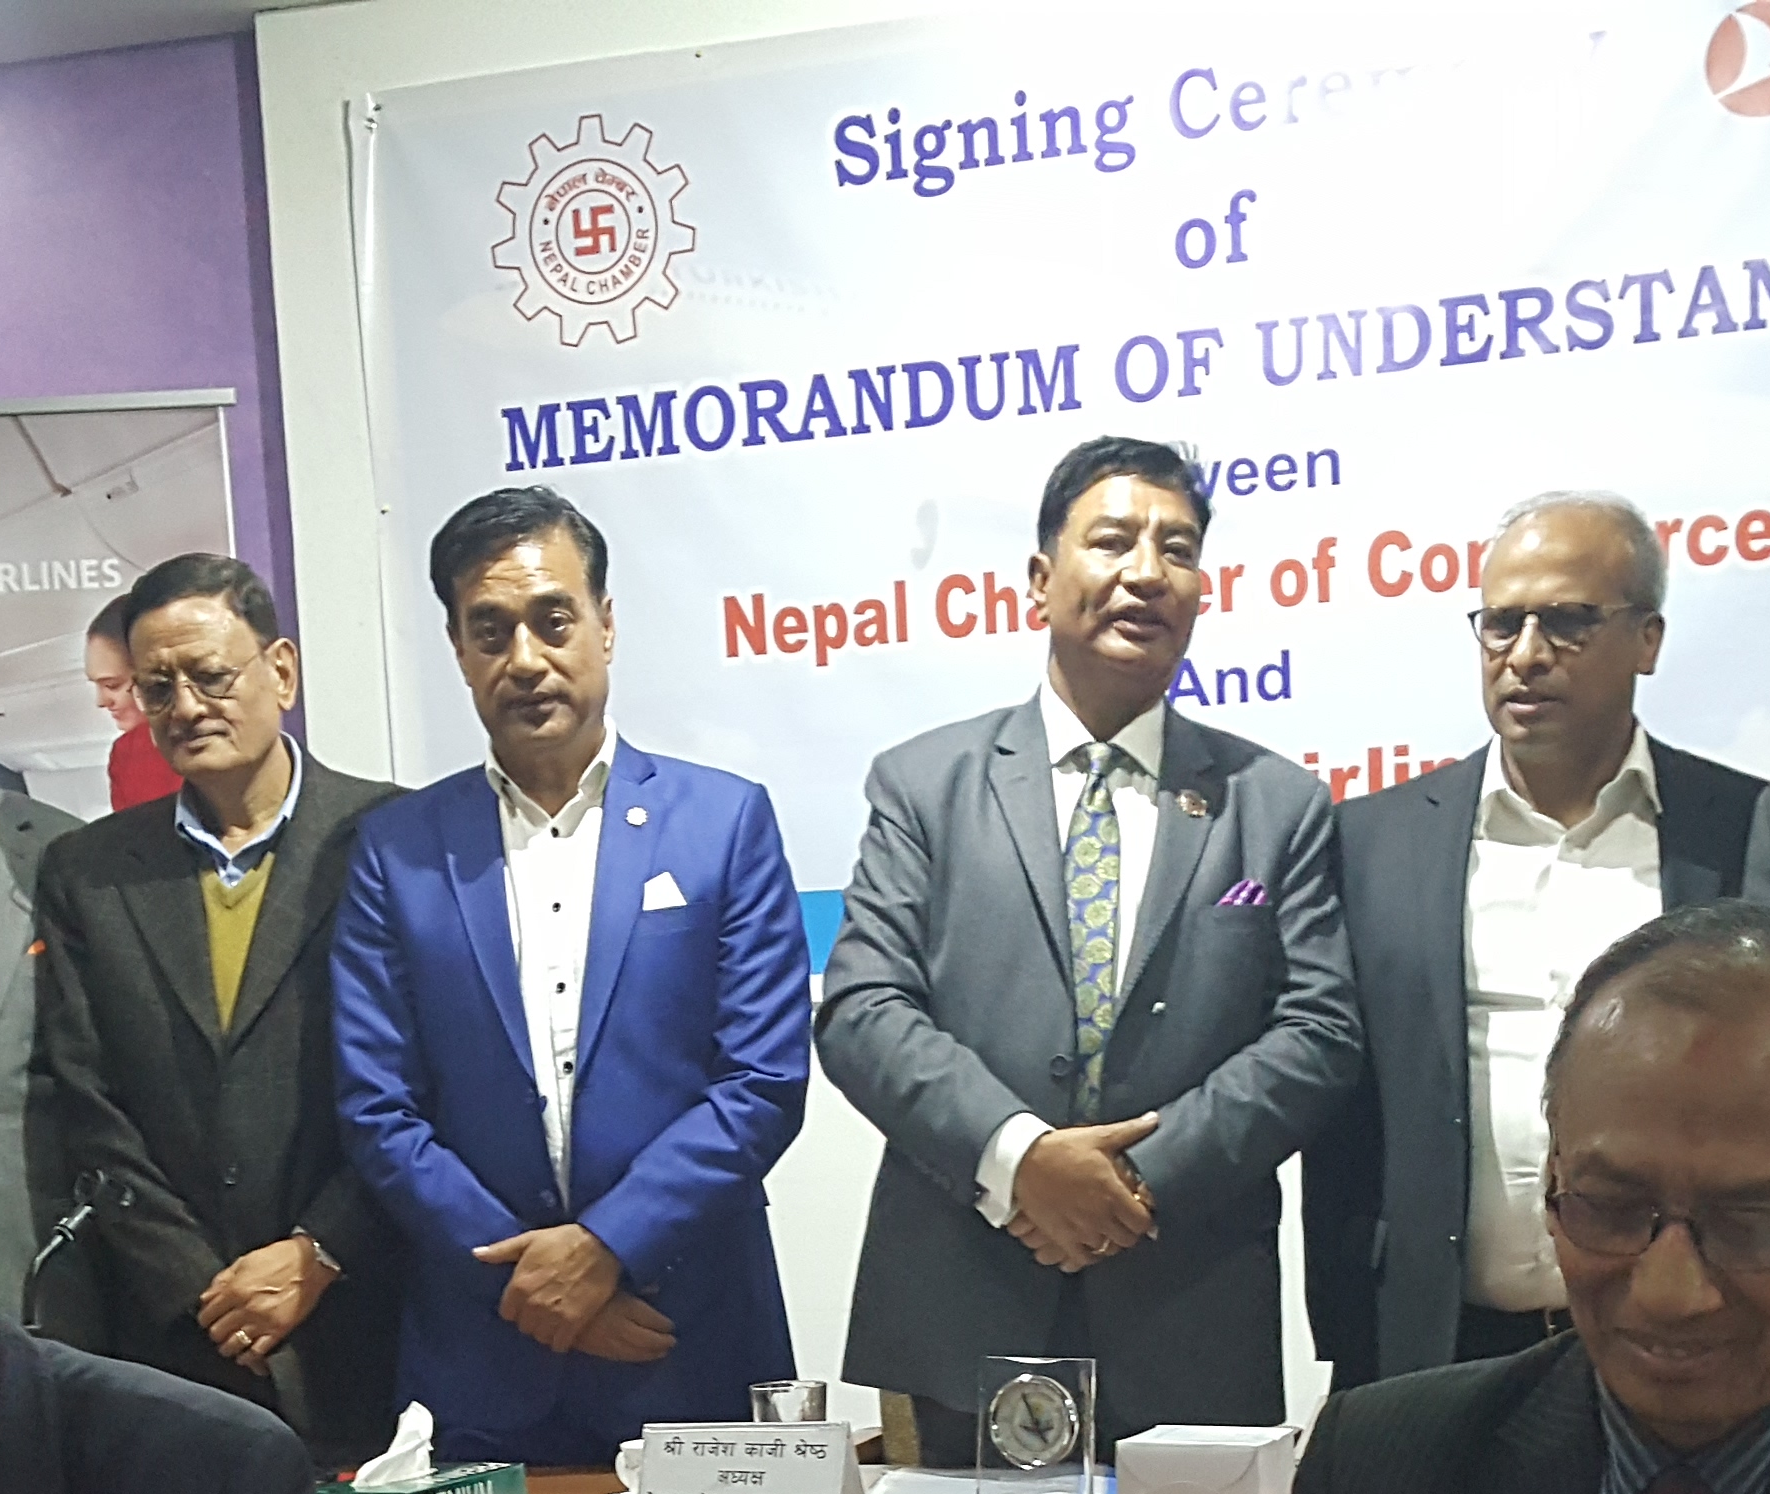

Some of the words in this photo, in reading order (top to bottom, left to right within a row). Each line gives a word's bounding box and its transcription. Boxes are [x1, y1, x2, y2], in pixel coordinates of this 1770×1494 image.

[834, 91, 1136, 198] Signing
[539, 240, 577, 293] NEPAL
[586, 228, 650, 295] CHAMBER
[1175, 189, 1257, 269] of
[501, 343, 1083, 474] MEMORANDUM
[1114, 327, 1225, 406] OF
[723, 579, 909, 668] Nepal
[1270, 536, 1338, 608] of
[1167, 649, 1293, 706] And
[692, 1437, 737, 1458] राजेश
[743, 1438, 787, 1459] काजी
